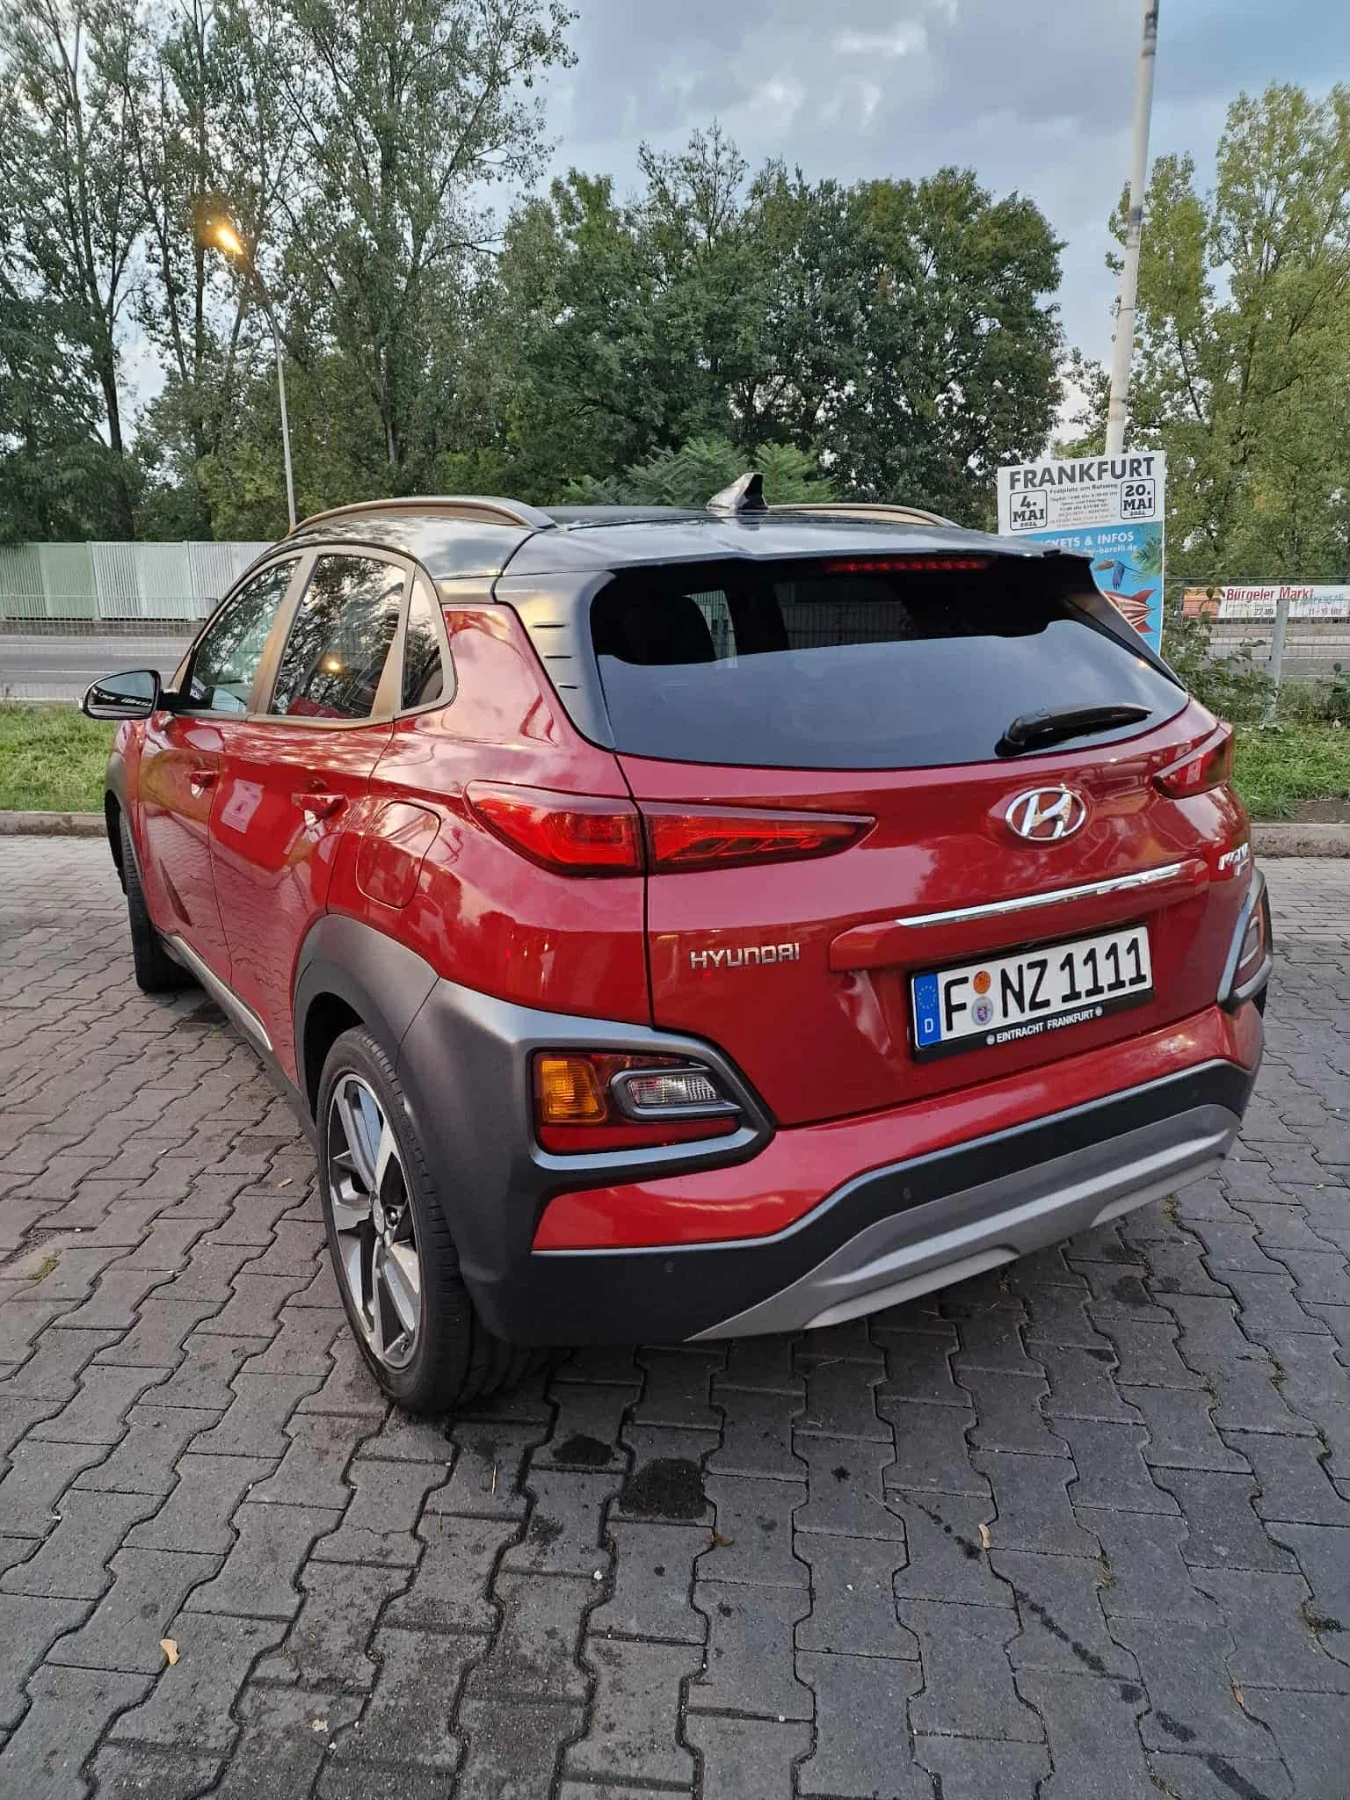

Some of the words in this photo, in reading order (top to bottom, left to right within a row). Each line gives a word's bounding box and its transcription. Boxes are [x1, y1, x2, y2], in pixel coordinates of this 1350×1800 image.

[1009, 456, 1155, 491] FRANKFURT
[1125, 484, 1151, 497] 20.
[1020, 495, 1037, 509] 4.
[1123, 498, 1153, 511] MAI
[1012, 508, 1045, 523] MAI
[1084, 536, 1093, 546] &
[1097, 532, 1134, 545] INFOS
[690, 942, 800, 969] HYUNDAI
[924, 1018, 934, 1033] D
[943, 976, 969, 1031] F
[1000, 959, 1051, 1018] NZ
[1060, 937, 1147, 1004] 1111
[996, 1022, 1044, 1043] EINTRACHT
[1047, 1008, 1095, 1029] FRANKFURT
